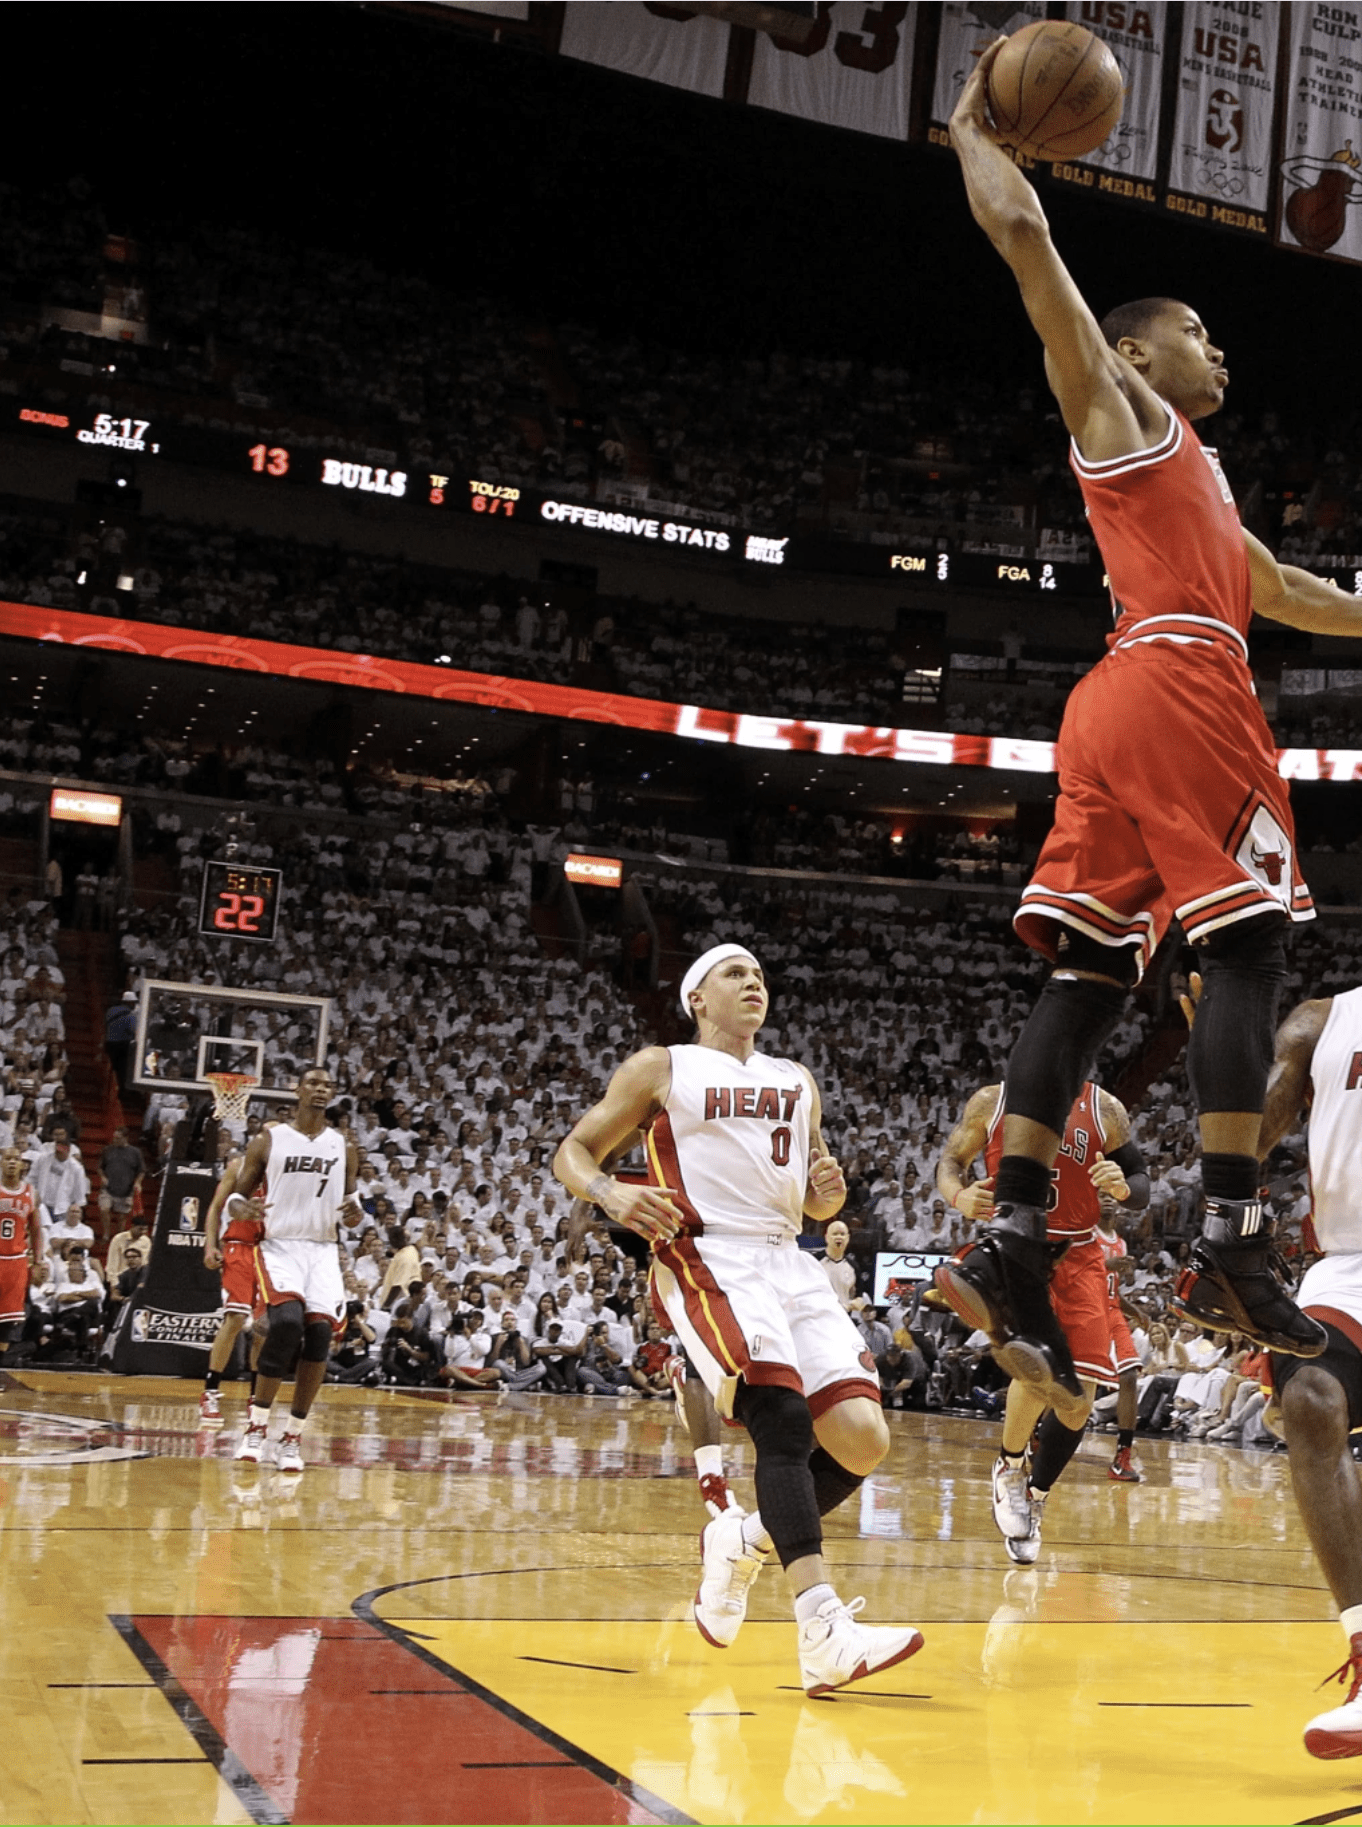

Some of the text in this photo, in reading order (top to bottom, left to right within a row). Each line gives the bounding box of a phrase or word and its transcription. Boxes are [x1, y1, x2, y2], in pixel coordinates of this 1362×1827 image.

[1081, 1, 1154, 38] USA
[1204, 1, 1262, 19] ADE
[1318, 3, 1357, 27] RON
[1213, 19, 1249, 37] 2008
[1313, 18, 1361, 41] CULP
[1195, 28, 1264, 72] USA
[1214, 65, 1271, 92] BASKETBALL
[1316, 65, 1353, 84] HEAD
[1051, 161, 1157, 202] GOLD MEDAL
[1166, 194, 1267, 233] GOLD MEDAL
[94, 413, 150, 440] 5:17
[77, 430, 145, 453] QUARTER
[248, 444, 290, 476] 13
[321, 458, 408, 498] BULLS
[429, 473, 450, 489] TF
[429, 488, 444, 505] 5
[540, 500, 659, 539] OFFENSIVE
[663, 522, 730, 551] STATS
[745, 547, 784, 565] BULLS
[890, 555, 926, 571] FGM
[937, 553, 949, 567] 2
[937, 566, 948, 580] 5
[998, 565, 1030, 581] FGA
[1039, 576, 1056, 590] 14
[676, 704, 957, 765] LET'S
[989, 737, 1058, 773] G
[227, 873, 272, 894] 5:17
[214, 892, 264, 932] 22
[704, 1083, 804, 1123] HEAT
[770, 1126, 791, 1166] 0
[283, 1156, 339, 1175] HEAT
[315, 1178, 329, 1198] 1
[1, 1217, 15, 1240] 6
[150, 1314, 224, 1329] EASTERN
[157, 1333, 206, 1343] FINALS
